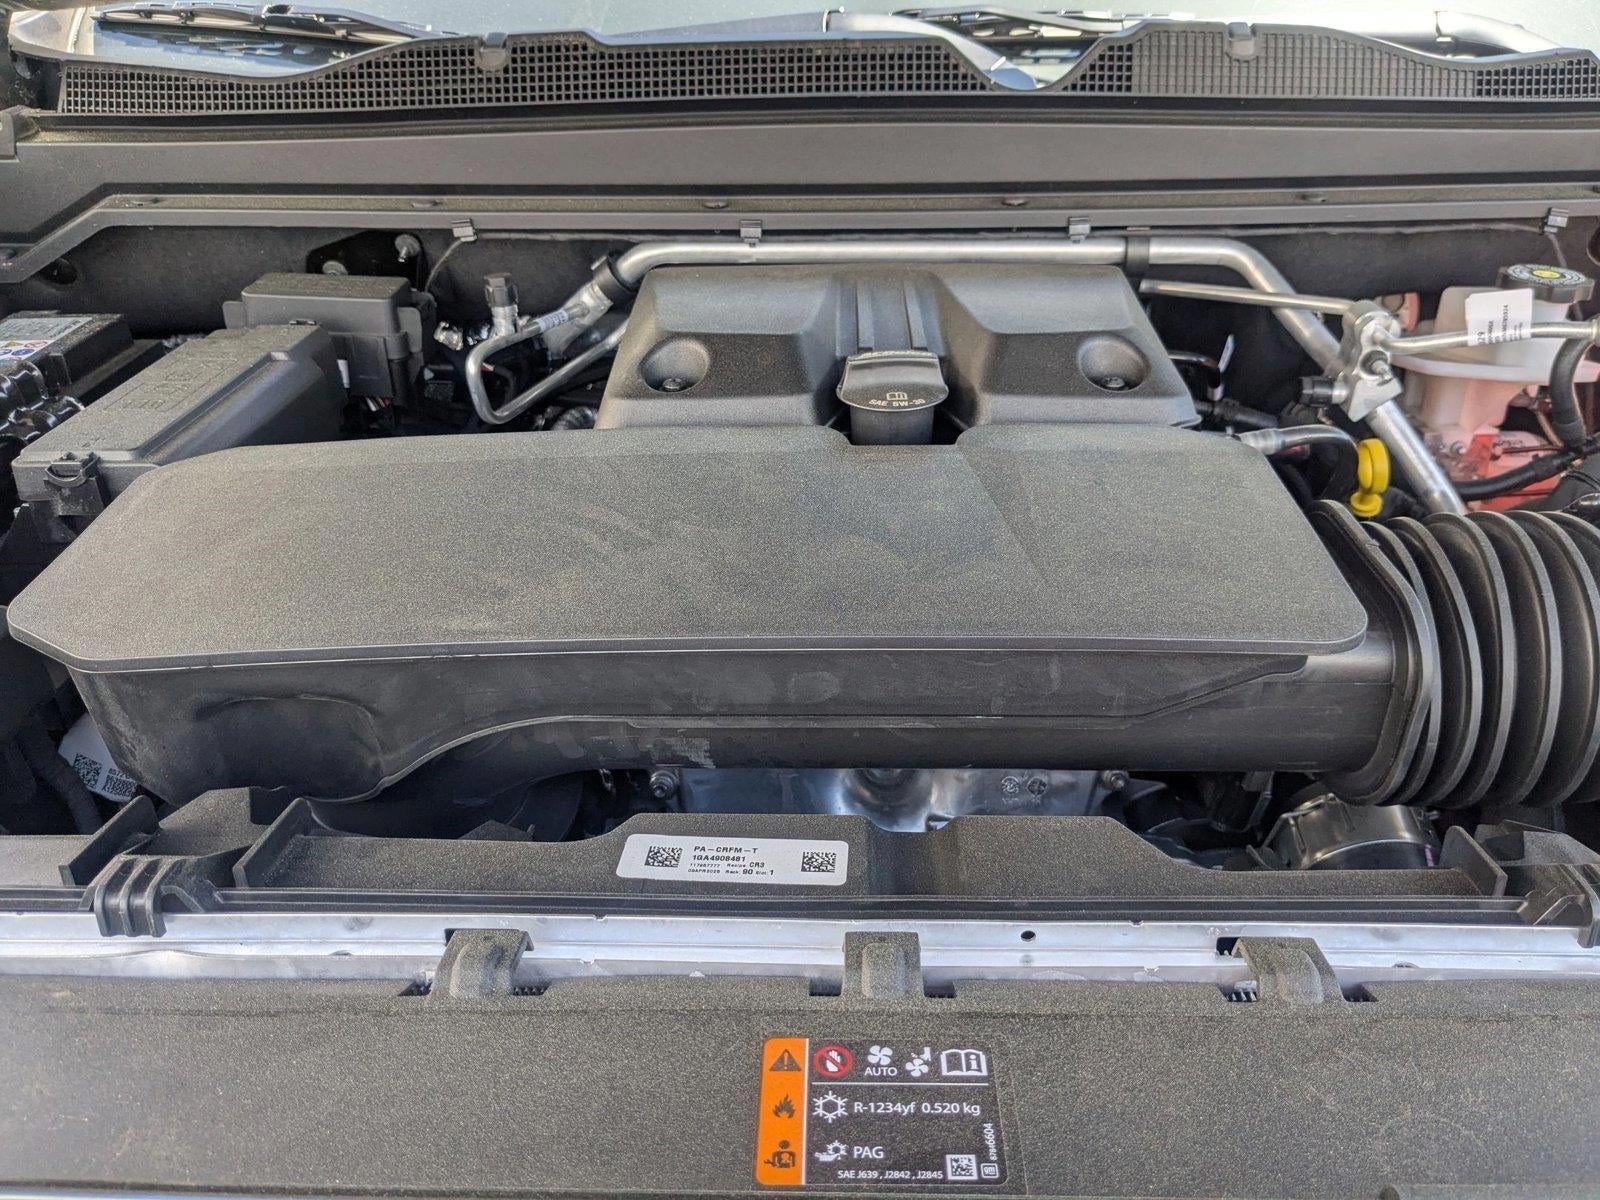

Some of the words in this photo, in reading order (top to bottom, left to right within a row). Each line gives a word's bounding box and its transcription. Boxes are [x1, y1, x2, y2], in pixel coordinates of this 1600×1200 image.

[869, 399, 888, 407] SAE
[864, 1067, 898, 1076] AUTO
[854, 1102, 916, 1116] R-1234yf
[921, 1102, 960, 1114] 0.520
[963, 1102, 981, 1116] kg
[853, 1146, 884, 1159] PAG
[837, 1170, 857, 1179] SAE
[917, 1171, 943, 1179] J2845
